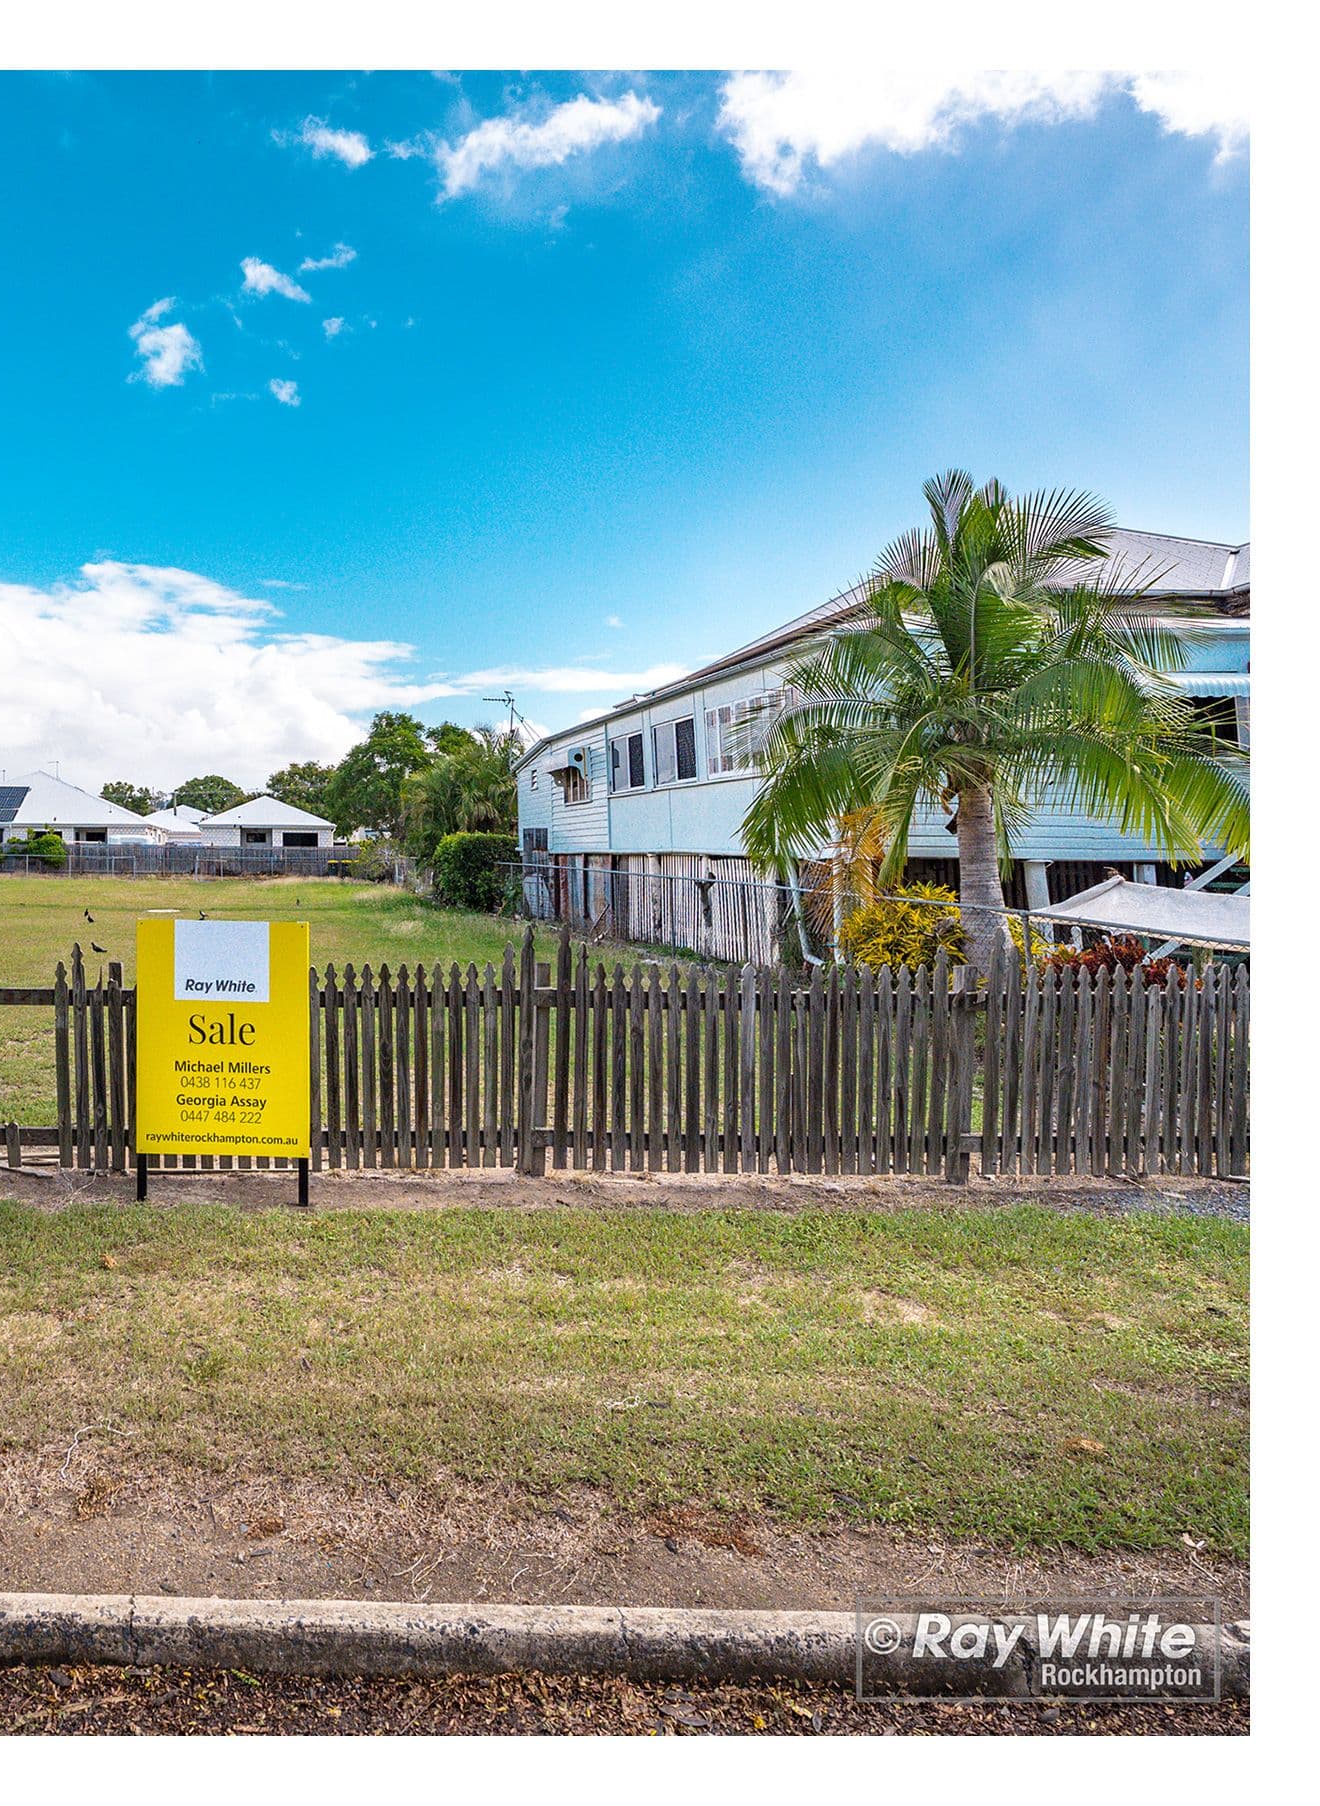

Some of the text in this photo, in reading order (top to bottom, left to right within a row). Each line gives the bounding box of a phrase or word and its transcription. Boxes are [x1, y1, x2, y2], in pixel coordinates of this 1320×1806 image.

[185, 978, 256, 994] Ray White
[188, 1013, 256, 1046] Sale
[174, 1060, 271, 1075] Michael Millers
[180, 1075, 262, 1090] 0438 116 437
[176, 1093, 267, 1110] Georgia Assay
[180, 1109, 262, 1124] 0447 484 222
[146, 1132, 298, 1145] raywhiterockhampton.com.au
